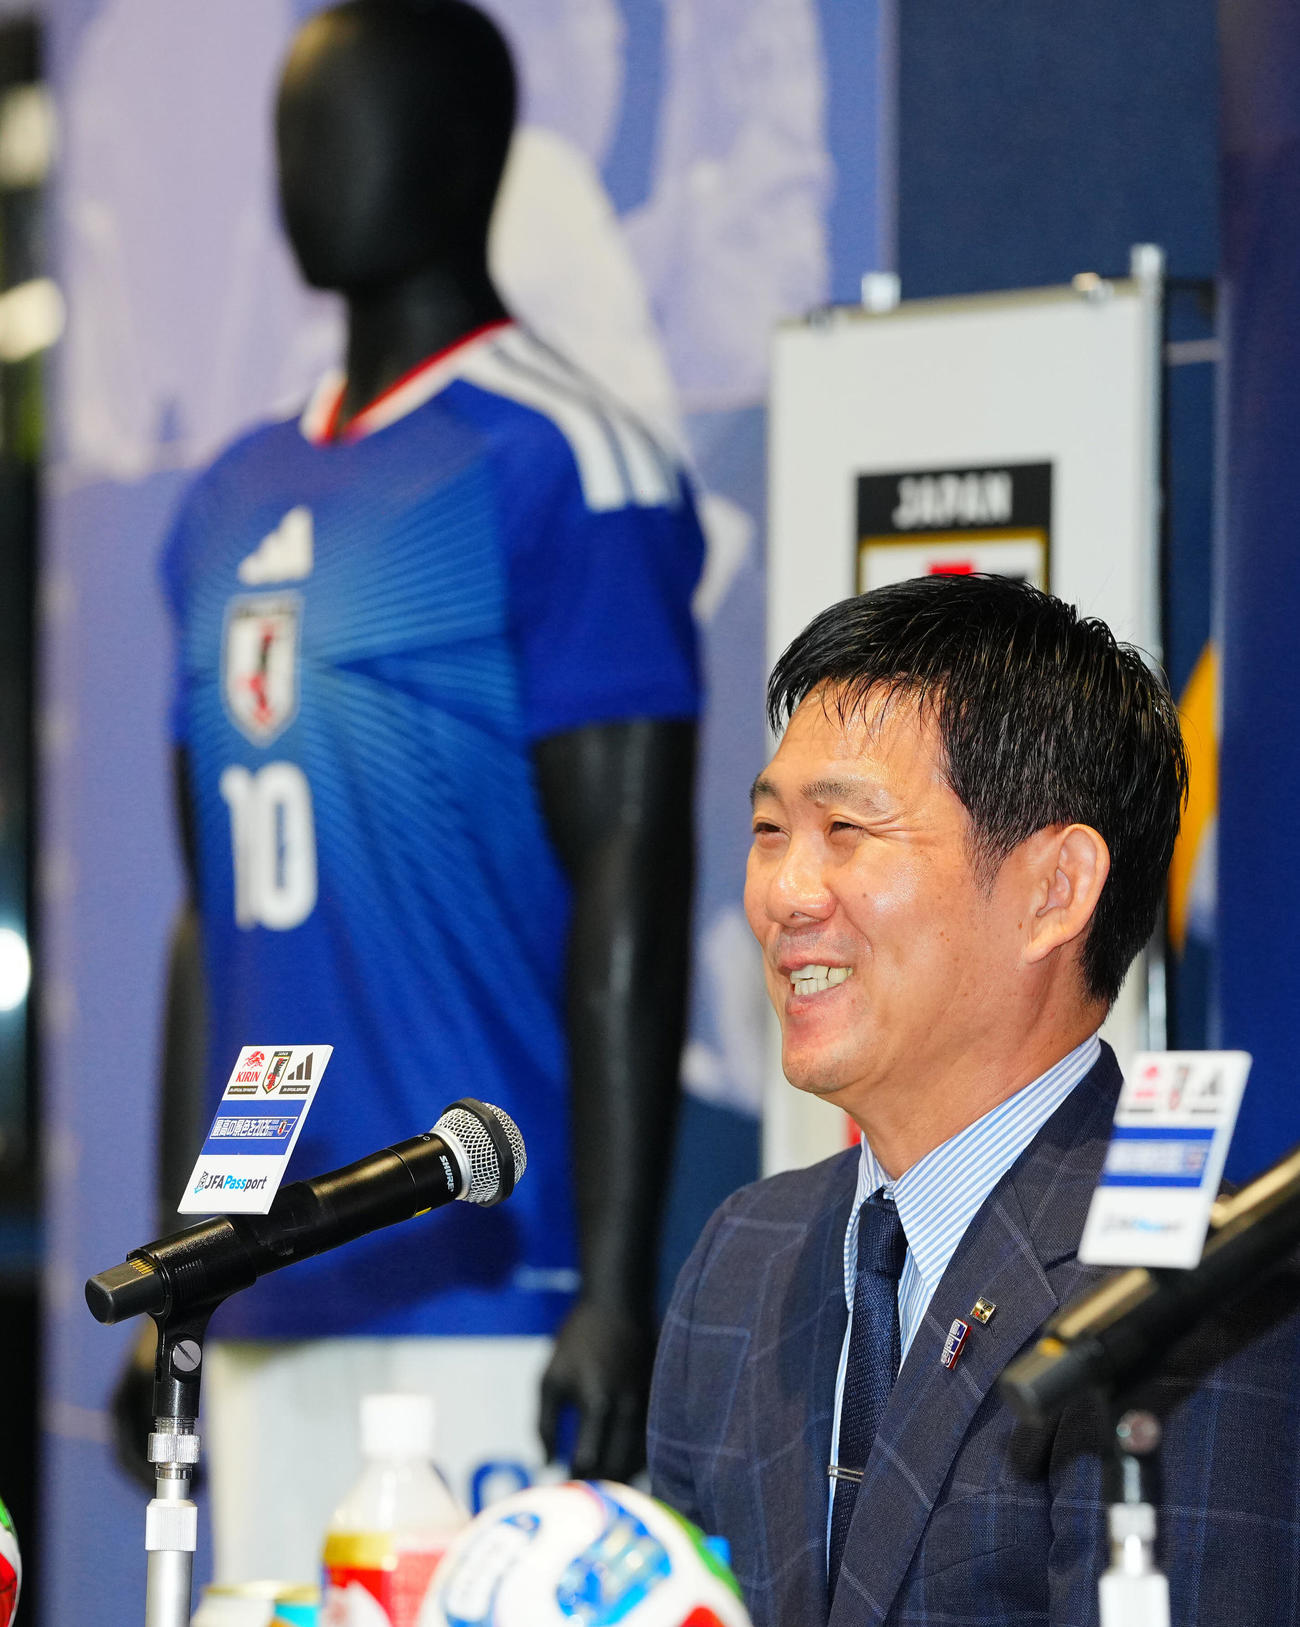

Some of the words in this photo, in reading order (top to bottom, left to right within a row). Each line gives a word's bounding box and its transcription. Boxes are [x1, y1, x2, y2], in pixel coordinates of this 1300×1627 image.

[893, 471, 1013, 529] JAPAN
[220, 762, 316, 930] 10
[236, 1072, 261, 1082] KIRIN
[439, 1155, 455, 1192] SHURE
